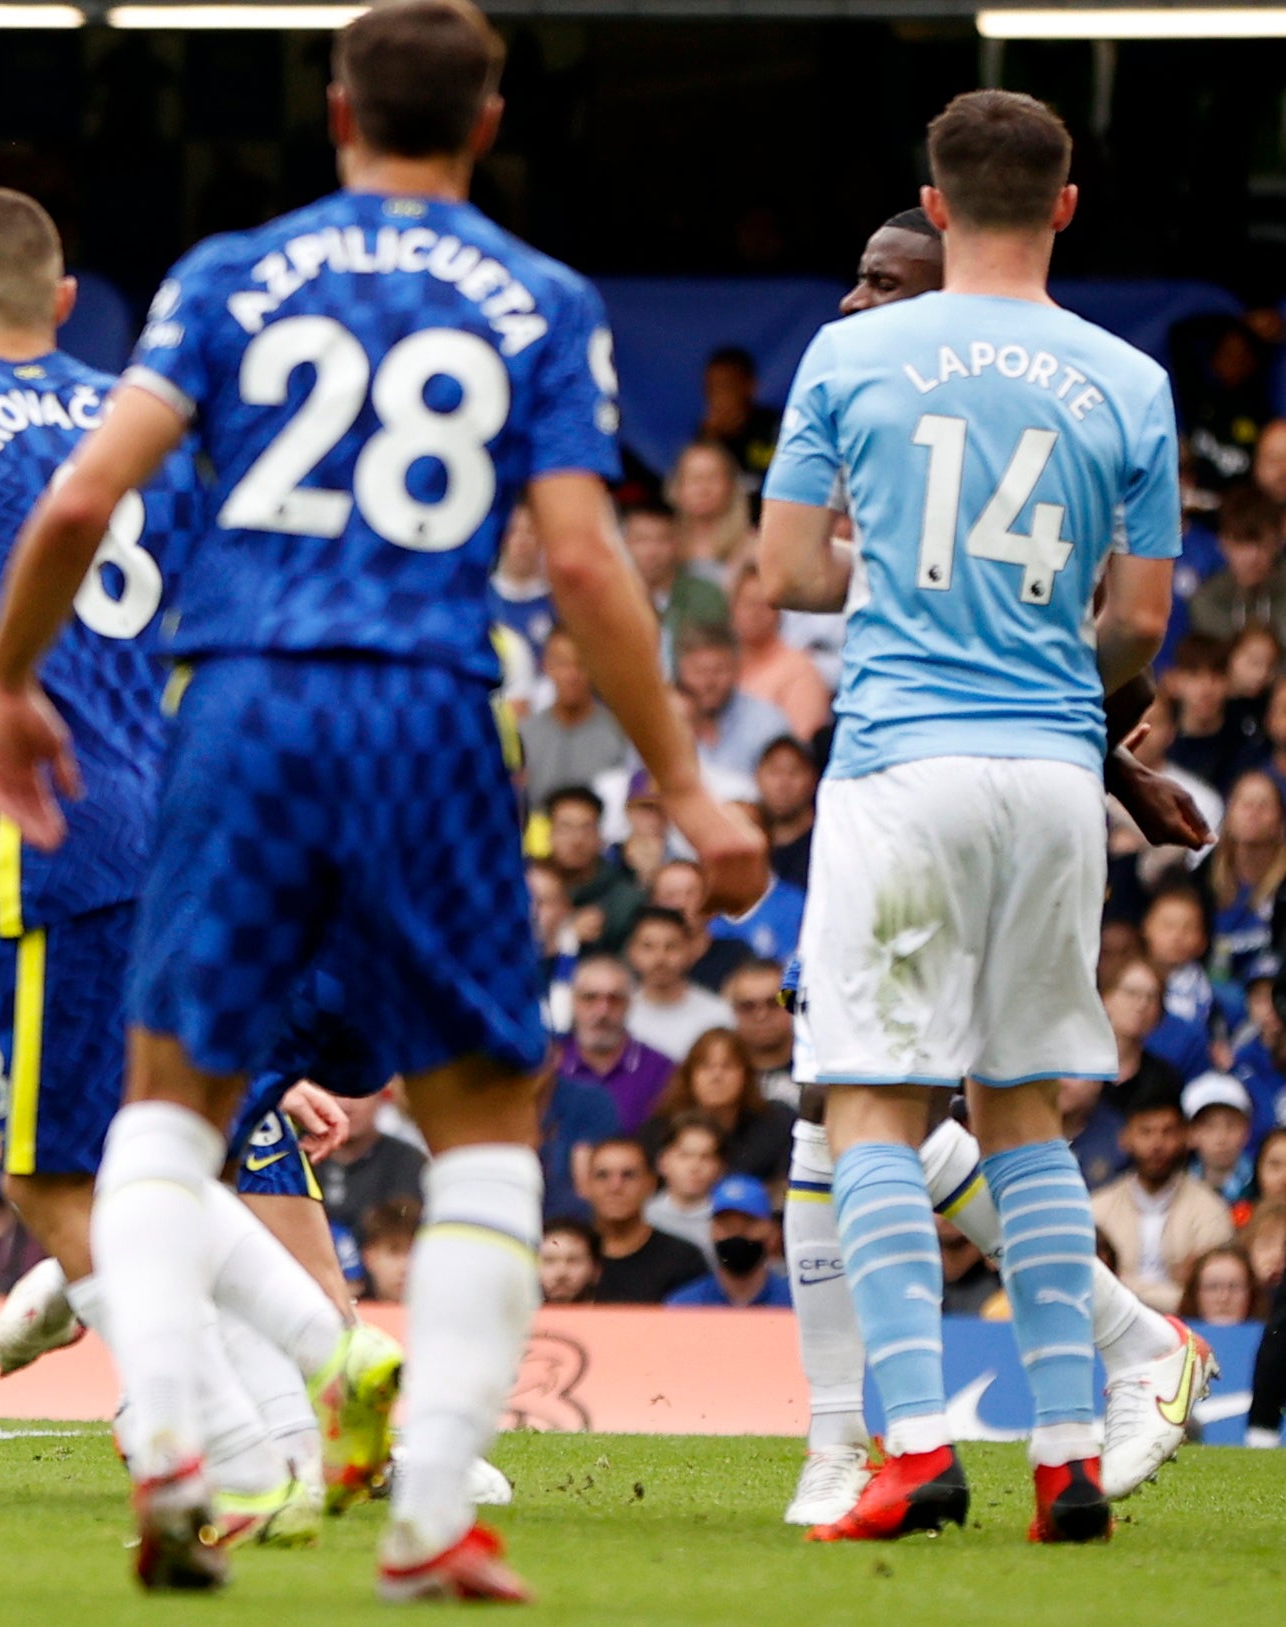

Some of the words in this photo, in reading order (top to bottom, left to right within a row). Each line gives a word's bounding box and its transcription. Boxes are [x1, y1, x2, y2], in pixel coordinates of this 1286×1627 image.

[227, 226, 548, 357] AZPILICUETA
[216, 313, 511, 553] 28
[902, 341, 1105, 421] LAPORTE
[911, 413, 1074, 606] 14
[799, 1258, 844, 1270] CFC
